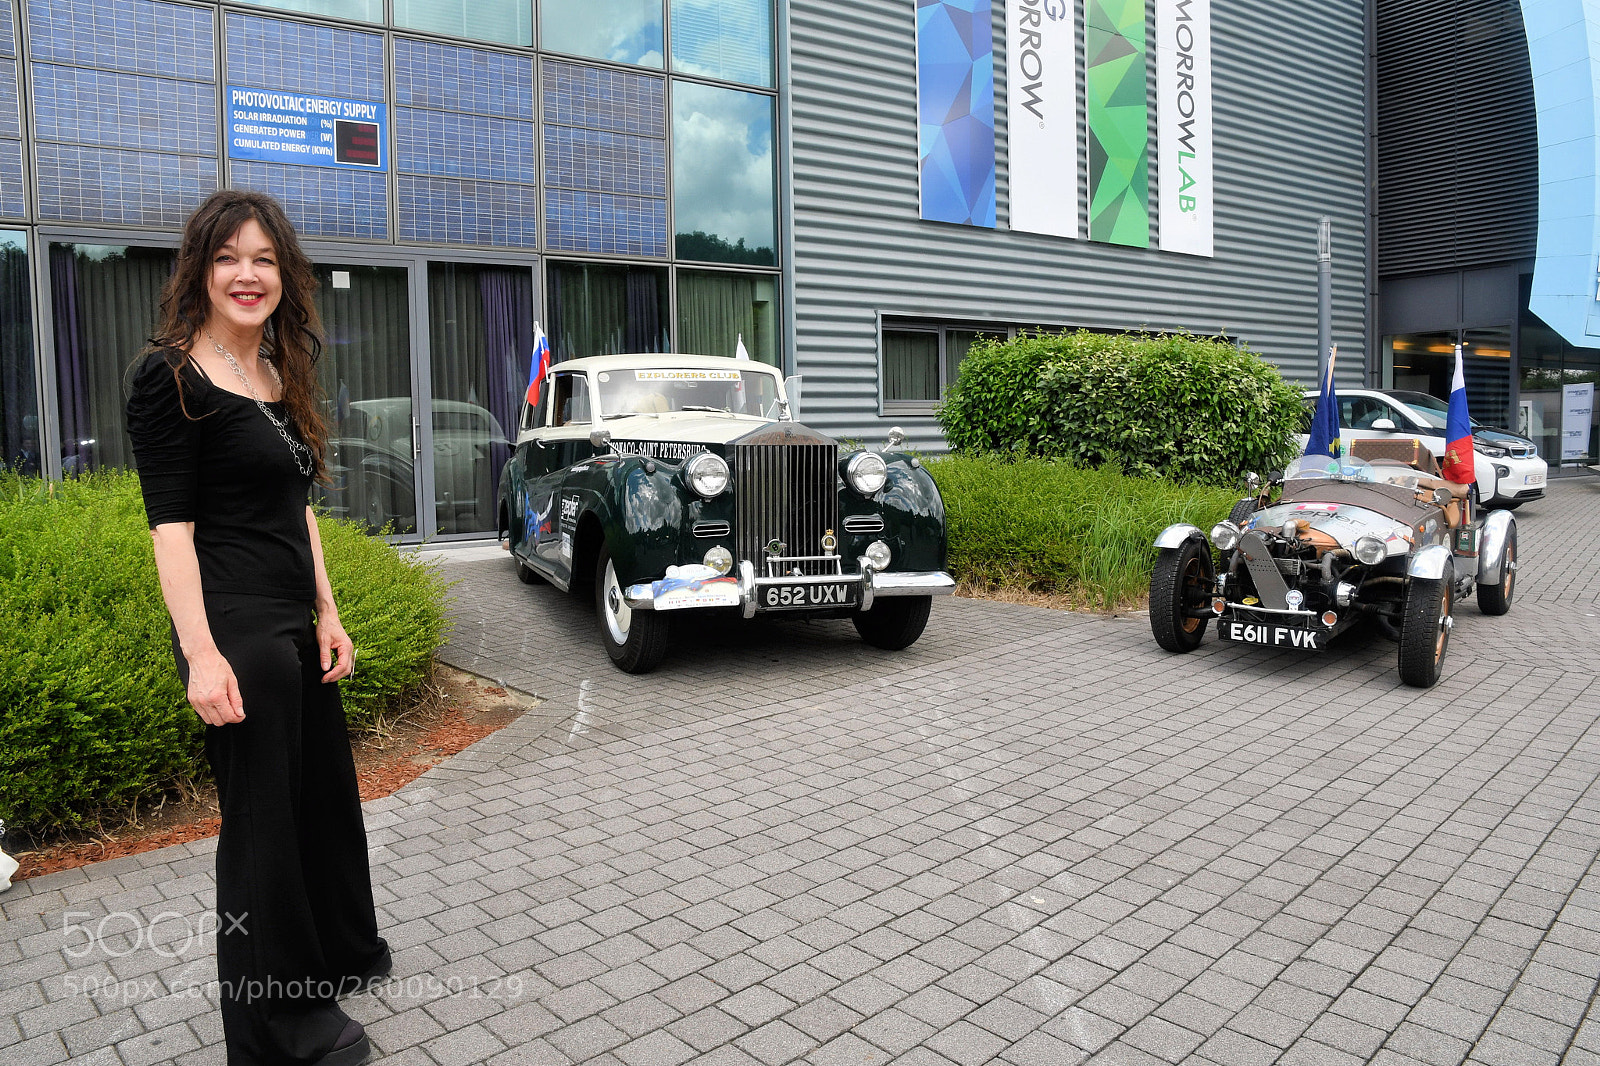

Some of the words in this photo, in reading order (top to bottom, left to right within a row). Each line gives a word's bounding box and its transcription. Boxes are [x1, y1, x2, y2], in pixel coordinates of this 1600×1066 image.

[1018, 0, 1044, 120] RROW
[232, 90, 304, 112] PHOTOVOLTAIC
[306, 100, 342, 116] ENERGY
[344, 102, 377, 119] SUPPLY
[233, 110, 259, 121] SOLAR
[259, 112, 308, 126] IRRADIATION
[233, 124, 278, 136] GENERATED
[278, 128, 306, 139] POWER
[233, 138, 281, 151] CUMULATED
[281, 143, 310, 155] ENERGY
[637, 371, 707, 380] EXPLORERS
[709, 372, 740, 380] CLUB
[766, 586, 805, 606] 652
[810, 584, 848, 604] UXW
[1230, 622, 1268, 644] E611
[1274, 627, 1317, 649] FVK
